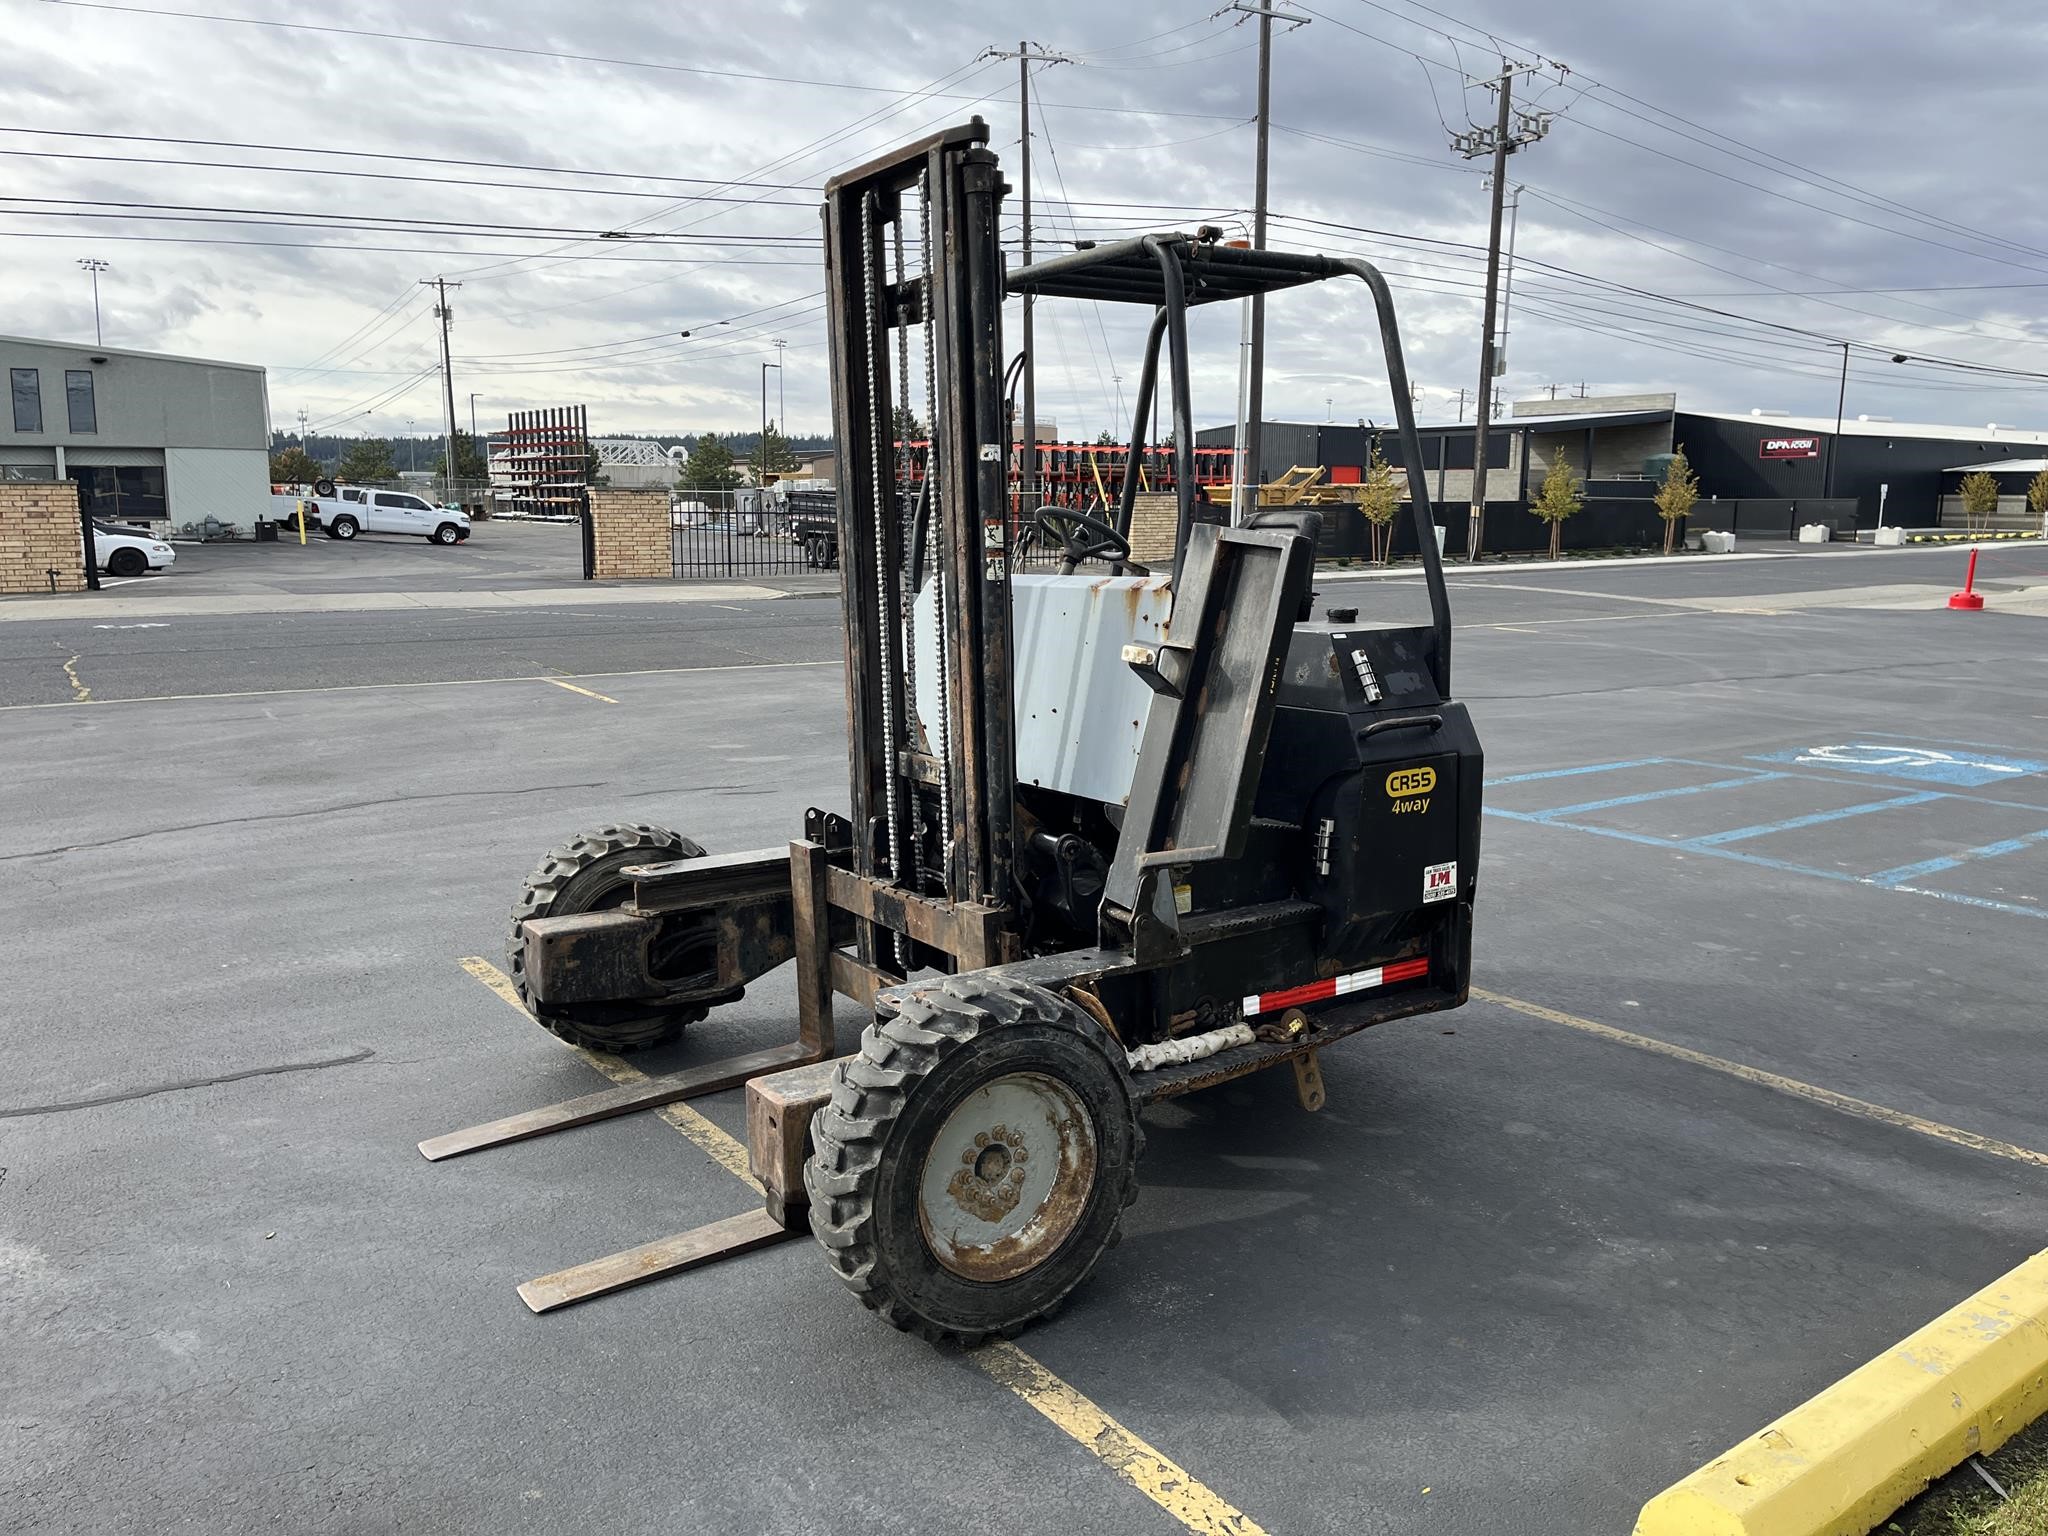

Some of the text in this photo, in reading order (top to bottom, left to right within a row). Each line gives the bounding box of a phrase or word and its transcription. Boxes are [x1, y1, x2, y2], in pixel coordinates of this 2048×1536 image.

[1766, 440, 1790, 450] DPA
[1390, 771, 1432, 792] CR55
[1391, 798, 1431, 814] 4way
